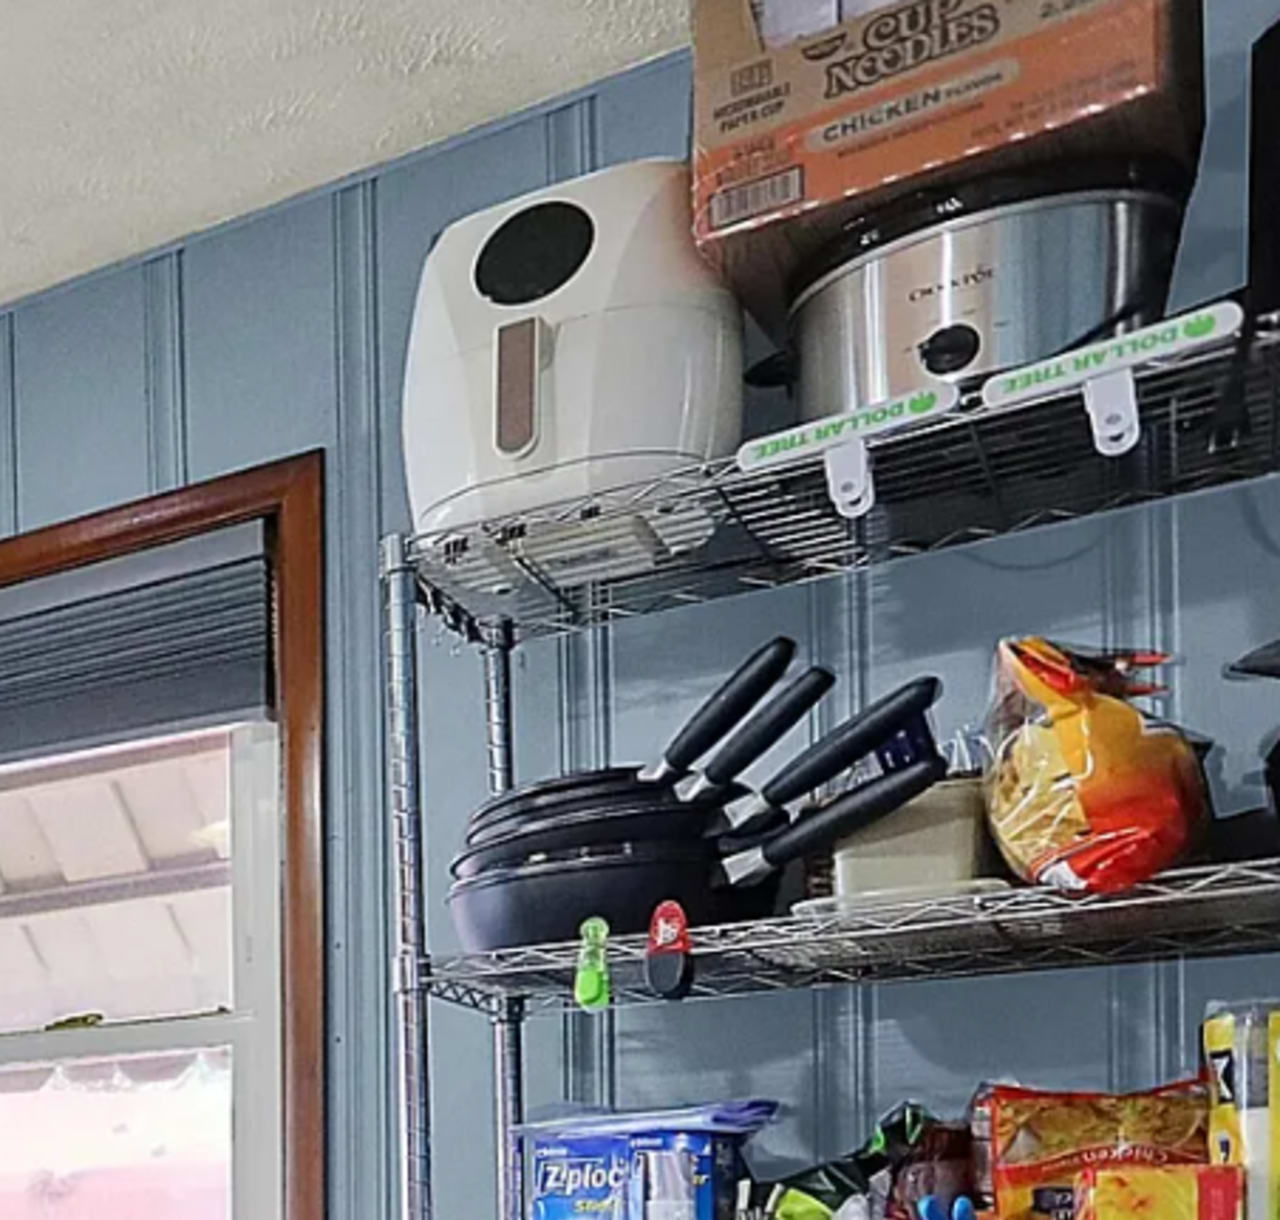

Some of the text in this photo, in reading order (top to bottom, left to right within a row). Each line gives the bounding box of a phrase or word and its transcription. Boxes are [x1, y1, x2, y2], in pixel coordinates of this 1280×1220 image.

[824, 4, 1000, 99] NOODLES
[863, 0, 961, 51] CUP
[823, 90, 941, 142] CHICKEN
[1003, 324, 1179, 394] DOLLAR TREE
[753, 402, 905, 461] DOLLAR TREE
[544, 1163, 625, 1196] Ziploc
